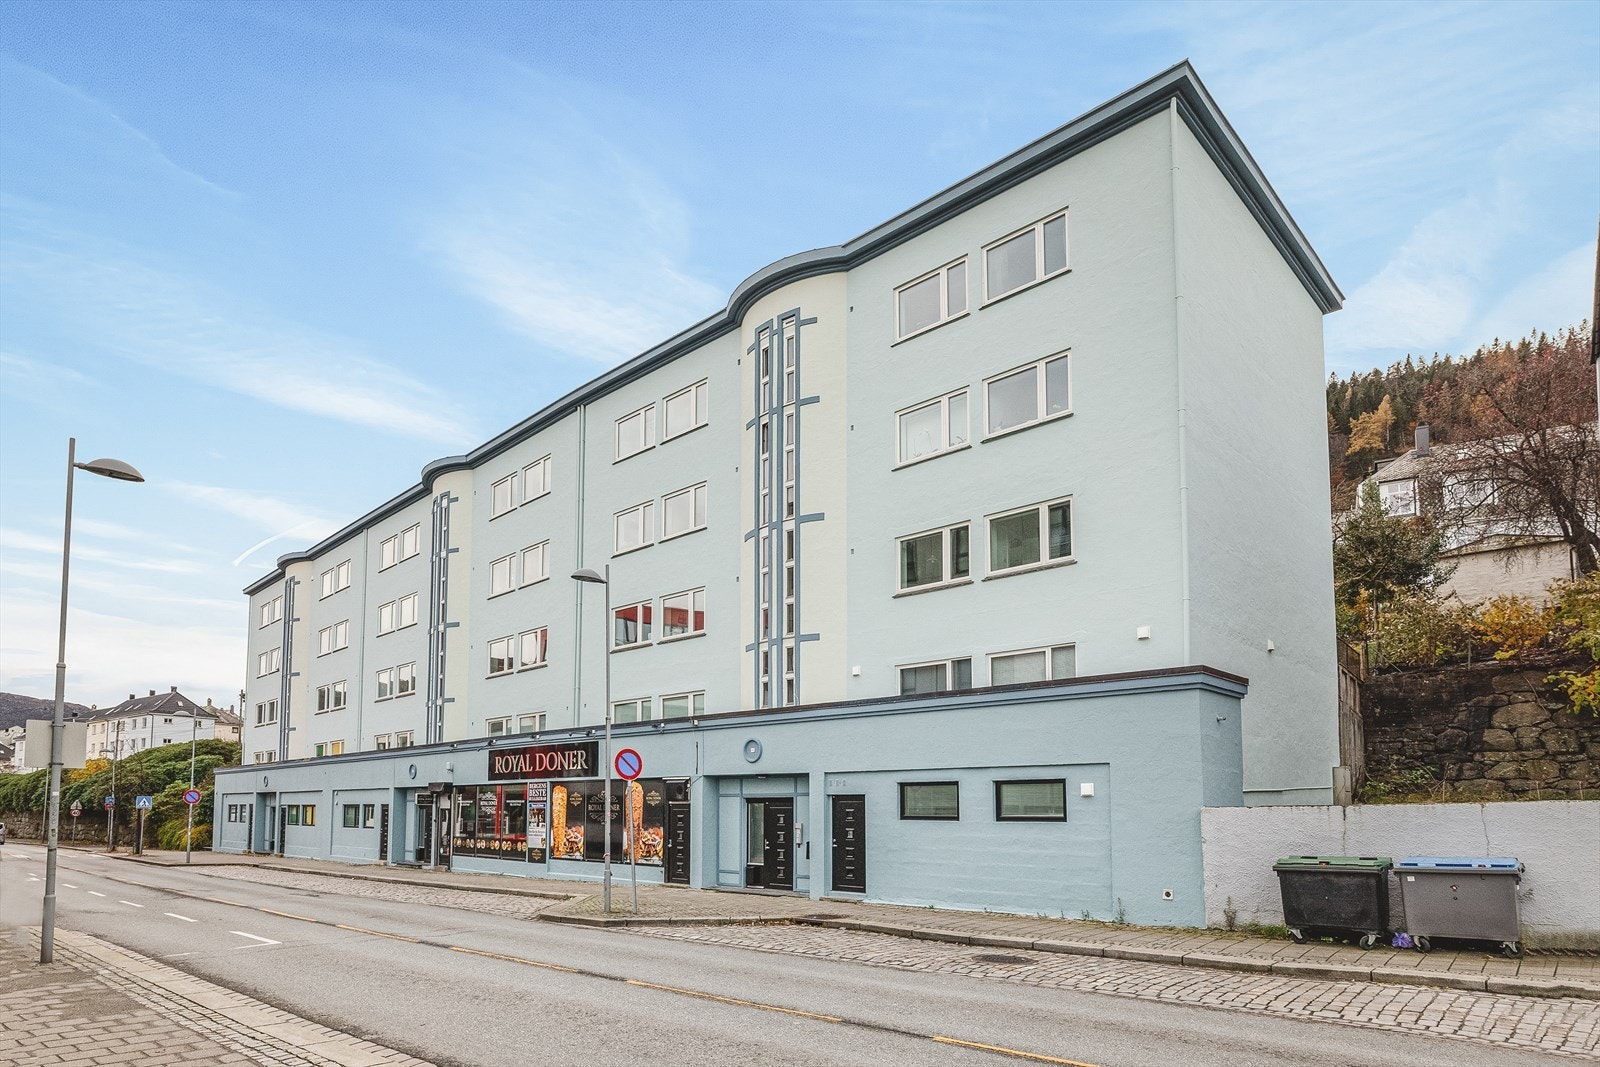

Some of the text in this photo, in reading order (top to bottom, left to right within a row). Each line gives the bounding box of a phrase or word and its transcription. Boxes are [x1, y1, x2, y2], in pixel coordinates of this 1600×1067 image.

[494, 749, 588, 774] ROYAL DONER
[529, 789, 547, 797] BESTE
